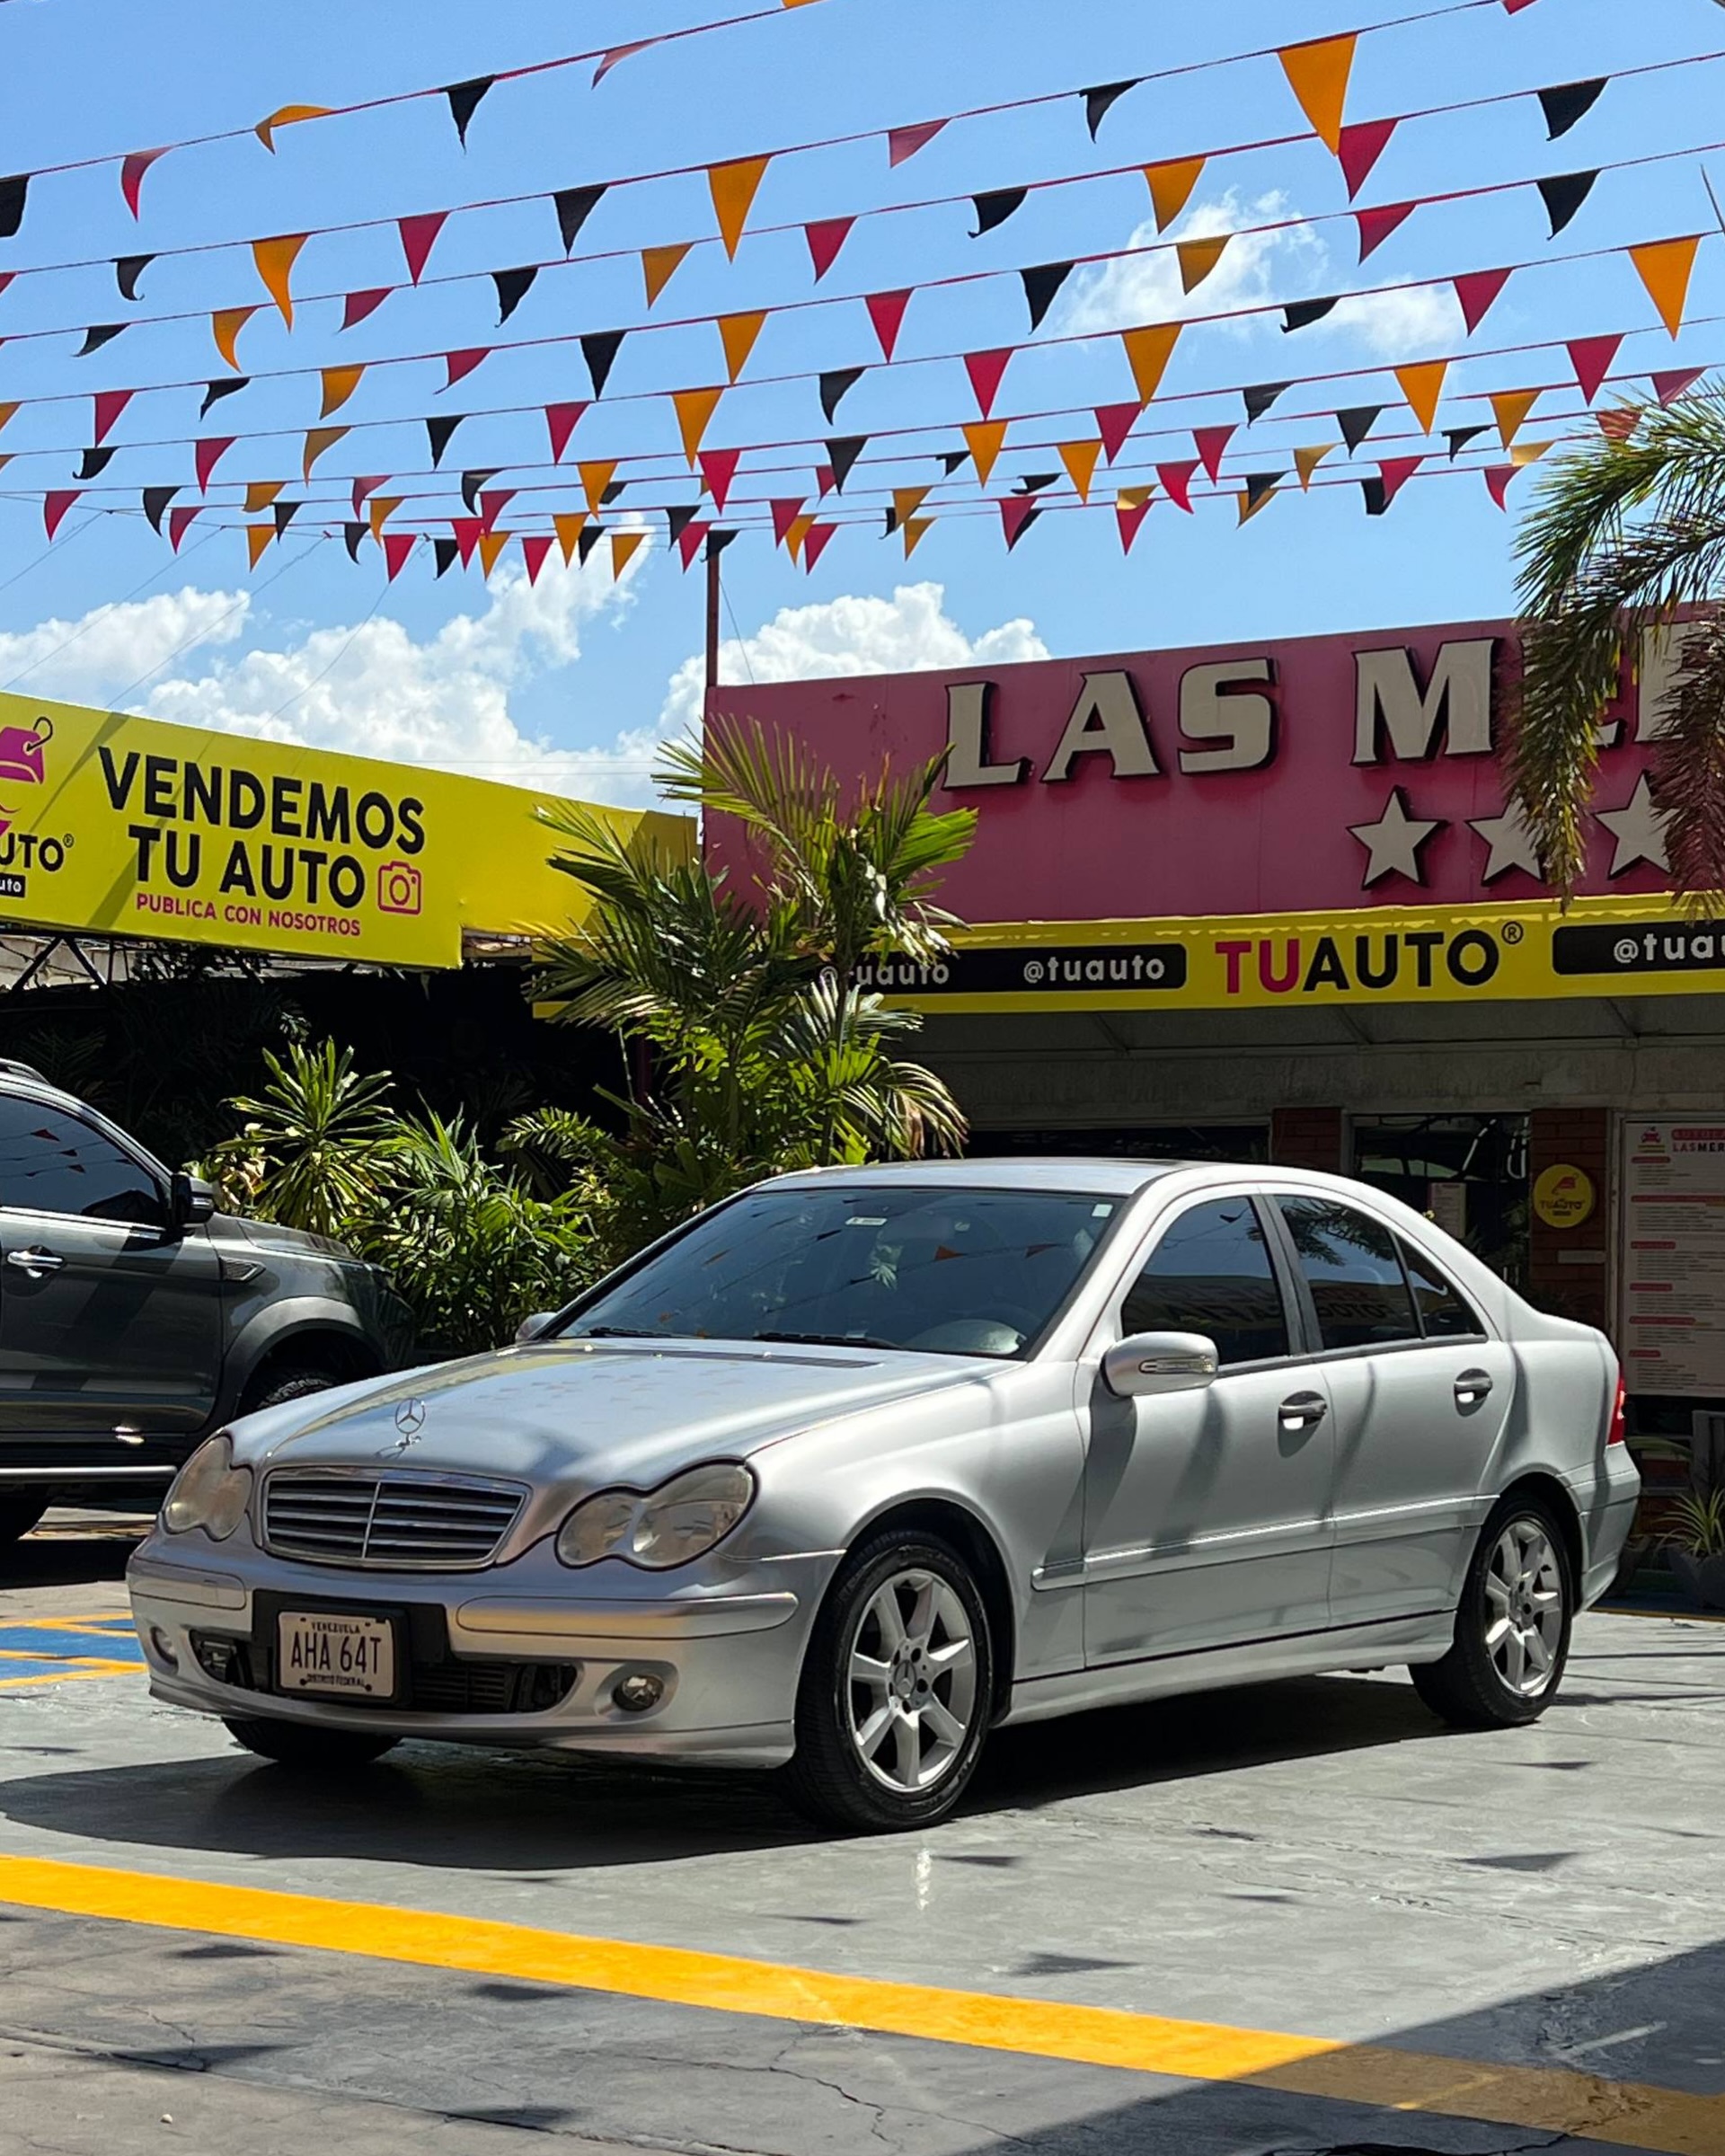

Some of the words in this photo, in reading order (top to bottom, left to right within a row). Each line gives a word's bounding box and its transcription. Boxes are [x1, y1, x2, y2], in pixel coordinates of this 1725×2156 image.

[942, 655, 1276, 792] LAS
[98, 746, 425, 854] VENDEMOS
[128, 824, 200, 888] TU
[218, 840, 366, 909] AUTO
[137, 892, 217, 920] PUBLICA
[225, 905, 261, 925] CON
[269, 909, 361, 936] NOSOTROS
[1023, 954, 1165, 985] @tuauto
[1613, 932, 1725, 964] @tua
[311, 1621, 361, 1634] VENEZUELA
[290, 1630, 331, 1671] AHA
[340, 1635, 382, 1675] 64T
